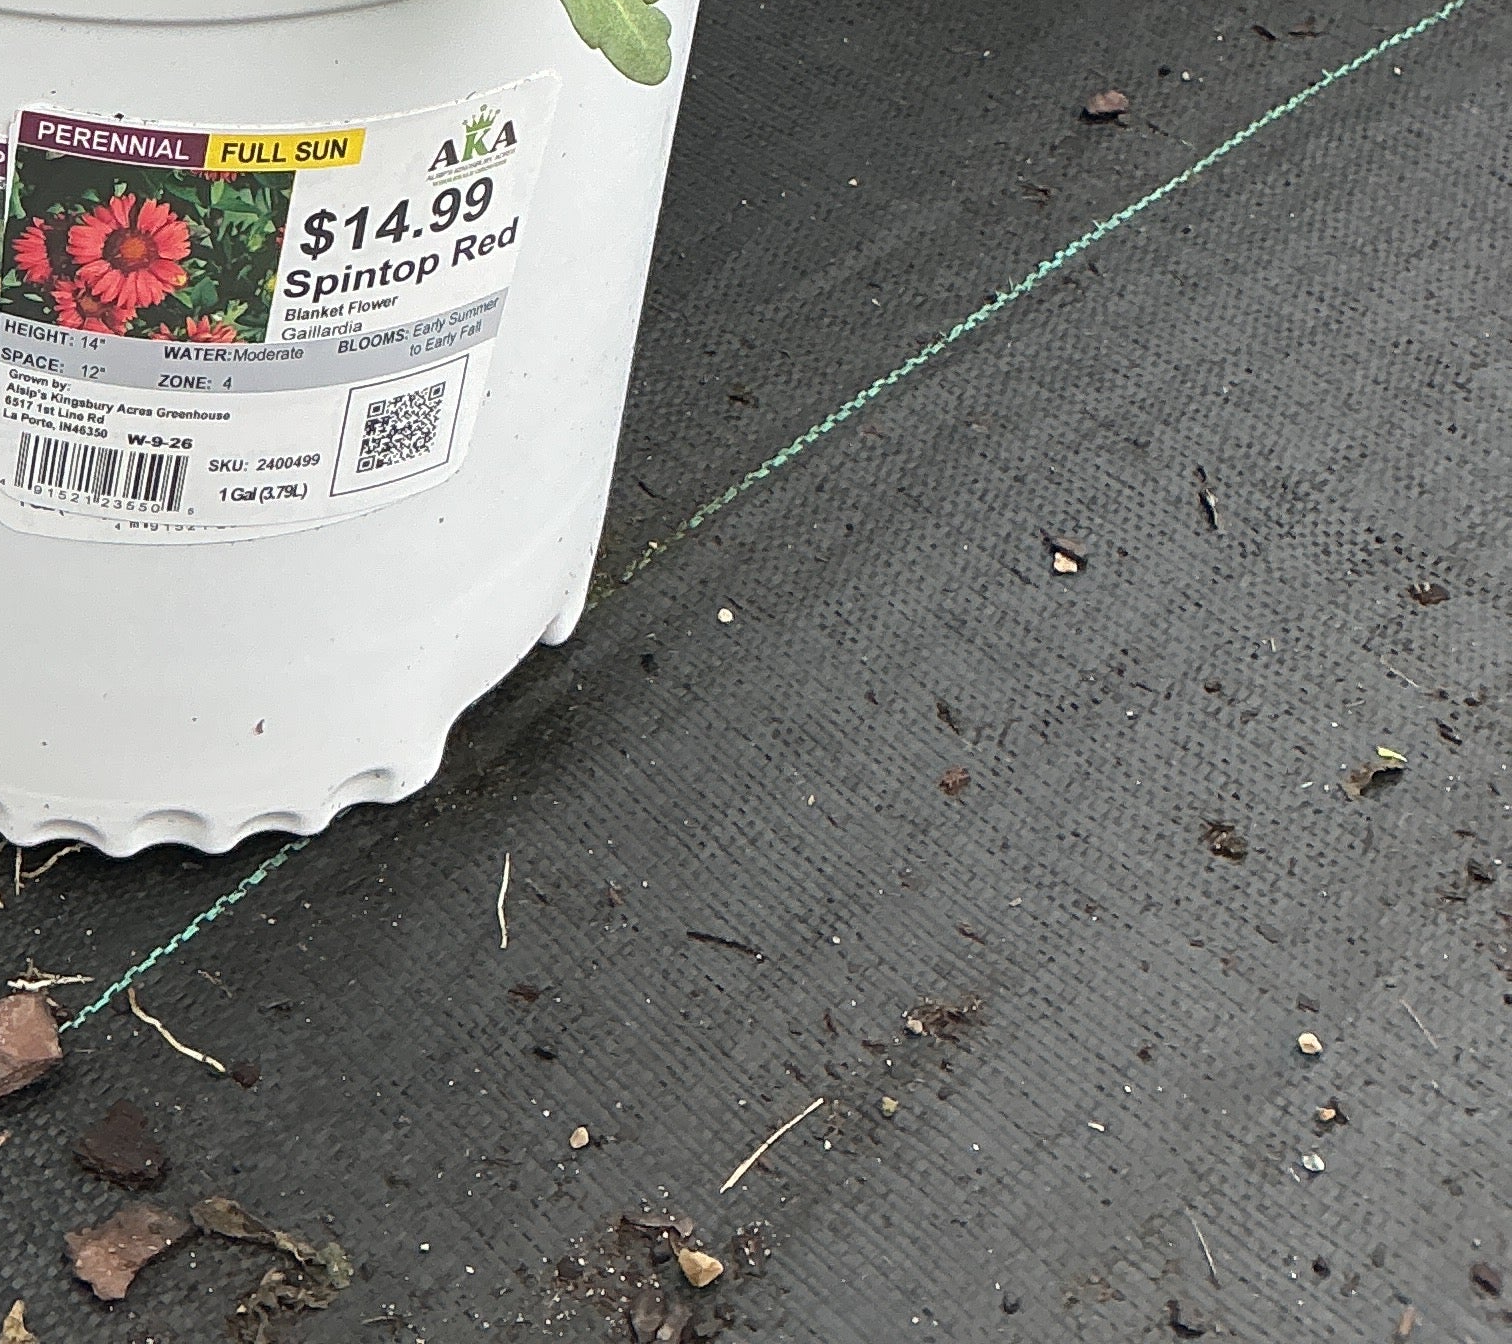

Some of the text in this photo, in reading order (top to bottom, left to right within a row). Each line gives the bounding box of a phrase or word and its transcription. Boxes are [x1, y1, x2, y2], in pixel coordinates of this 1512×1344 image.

[38, 120, 349, 164] PERENNIAL FULL SUN
[428, 120, 518, 172] AKA
[300, 176, 495, 261] $14.99
[283, 216, 520, 304] Spintop Red
[284, 295, 400, 322] Blanket Flower
[4, 318, 106, 351] HEIGHT: 14"
[281, 320, 363, 341] Gaillardia
[337, 297, 500, 354] BLOOMS: Early Summer
[409, 318, 483, 358] to Early Fall
[0, 347, 65, 374] SPACE:
[80, 363, 106, 381] 12"
[9, 368, 49, 387] Grown
[51, 378, 72, 393] by:
[157, 374, 233, 391] ZONE: 4
[5, 381, 48, 400] Alsip's
[50, 391, 115, 413] Kingsbury
[117, 403, 153, 418] Acres
[156, 407, 232, 422] Greenhouse
[37, 402, 56, 416] 1st
[58, 407, 85, 423] Line
[86, 413, 106, 426] Rd
[3, 408, 18, 420] La
[20, 412, 56, 432] Porte,
[127, 433, 195, 450] W-9-26
[208, 452, 322, 473] SKU: 2400499
